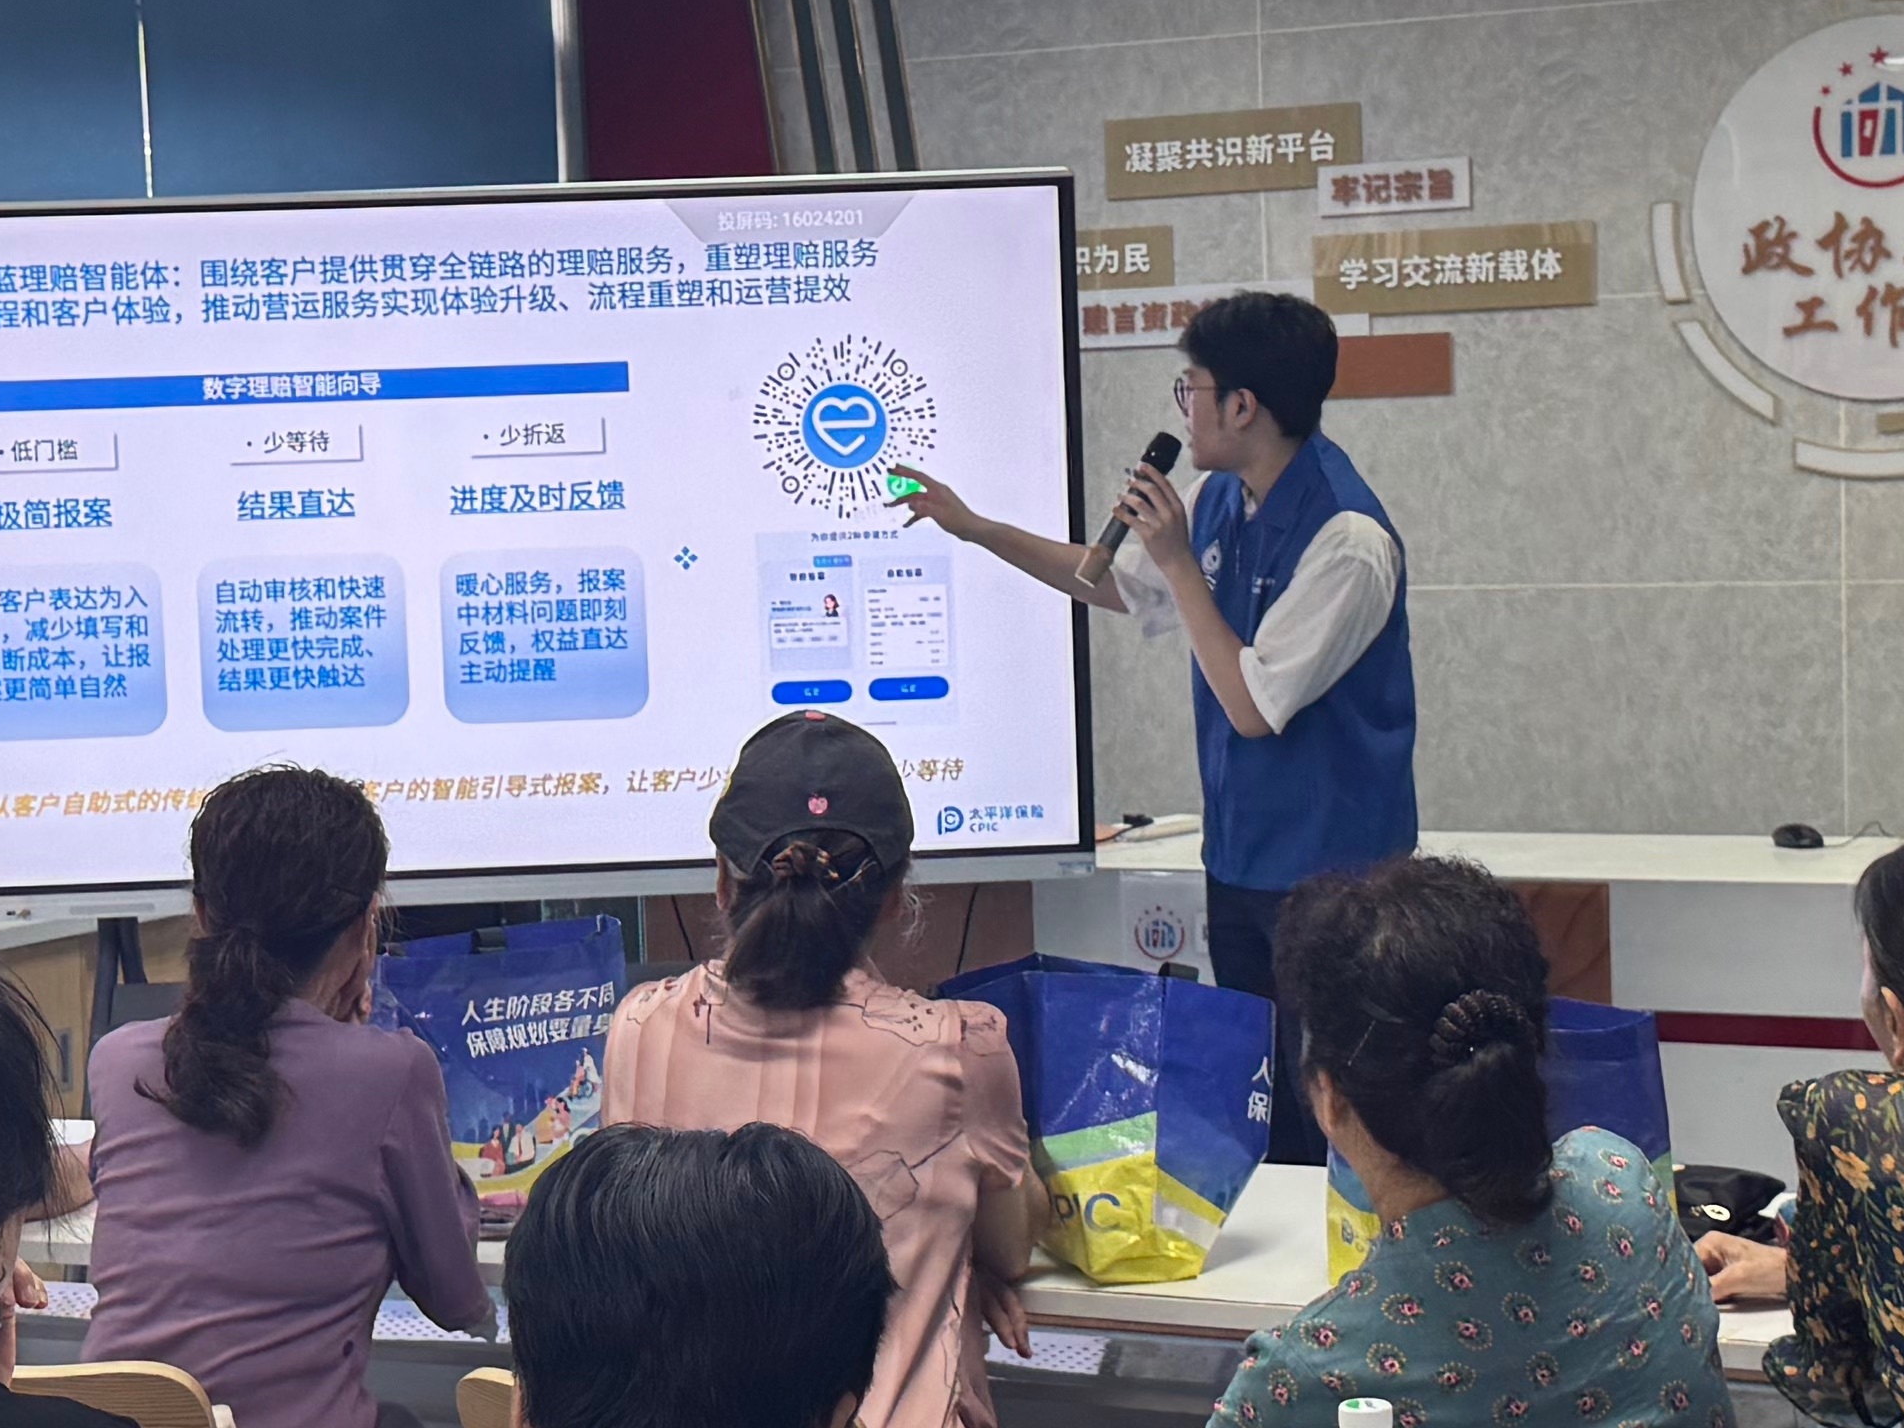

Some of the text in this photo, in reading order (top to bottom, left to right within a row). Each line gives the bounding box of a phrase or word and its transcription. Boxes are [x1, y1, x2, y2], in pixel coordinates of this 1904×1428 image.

[1125, 128, 1337, 174] 凝聚共识新平台
[1330, 169, 1457, 207] 牢记宗旨
[783, 209, 864, 228] 16024201
[1339, 248, 1564, 290] 学习交流新载体
[1081, 299, 1214, 337] 建言资政
[203, 372, 383, 401] 数字理赔智能向导
[264, 430, 330, 455] 少等待
[500, 423, 567, 447] 少折返
[10, 438, 78, 463] 低门槛
[237, 487, 356, 521] 结果直达
[450, 480, 626, 515] 进度及时反馈
[215, 575, 386, 605] 自动审核和快速
[455, 567, 627, 598] 暖心服务，报案
[215, 605, 387, 634] 流转，推动案件
[456, 597, 627, 626] 中材料问题即刻
[216, 635, 376, 663] 处理更快完成、
[458, 627, 628, 655] 反馈，权益直达
[218, 663, 365, 692] 结果更快触达
[459, 658, 557, 685] 主动提醒
[969, 805, 1044, 821] 太平洋保险
[969, 823, 998, 832] CPIC
[461, 981, 614, 1026] 人生阶段各不同
